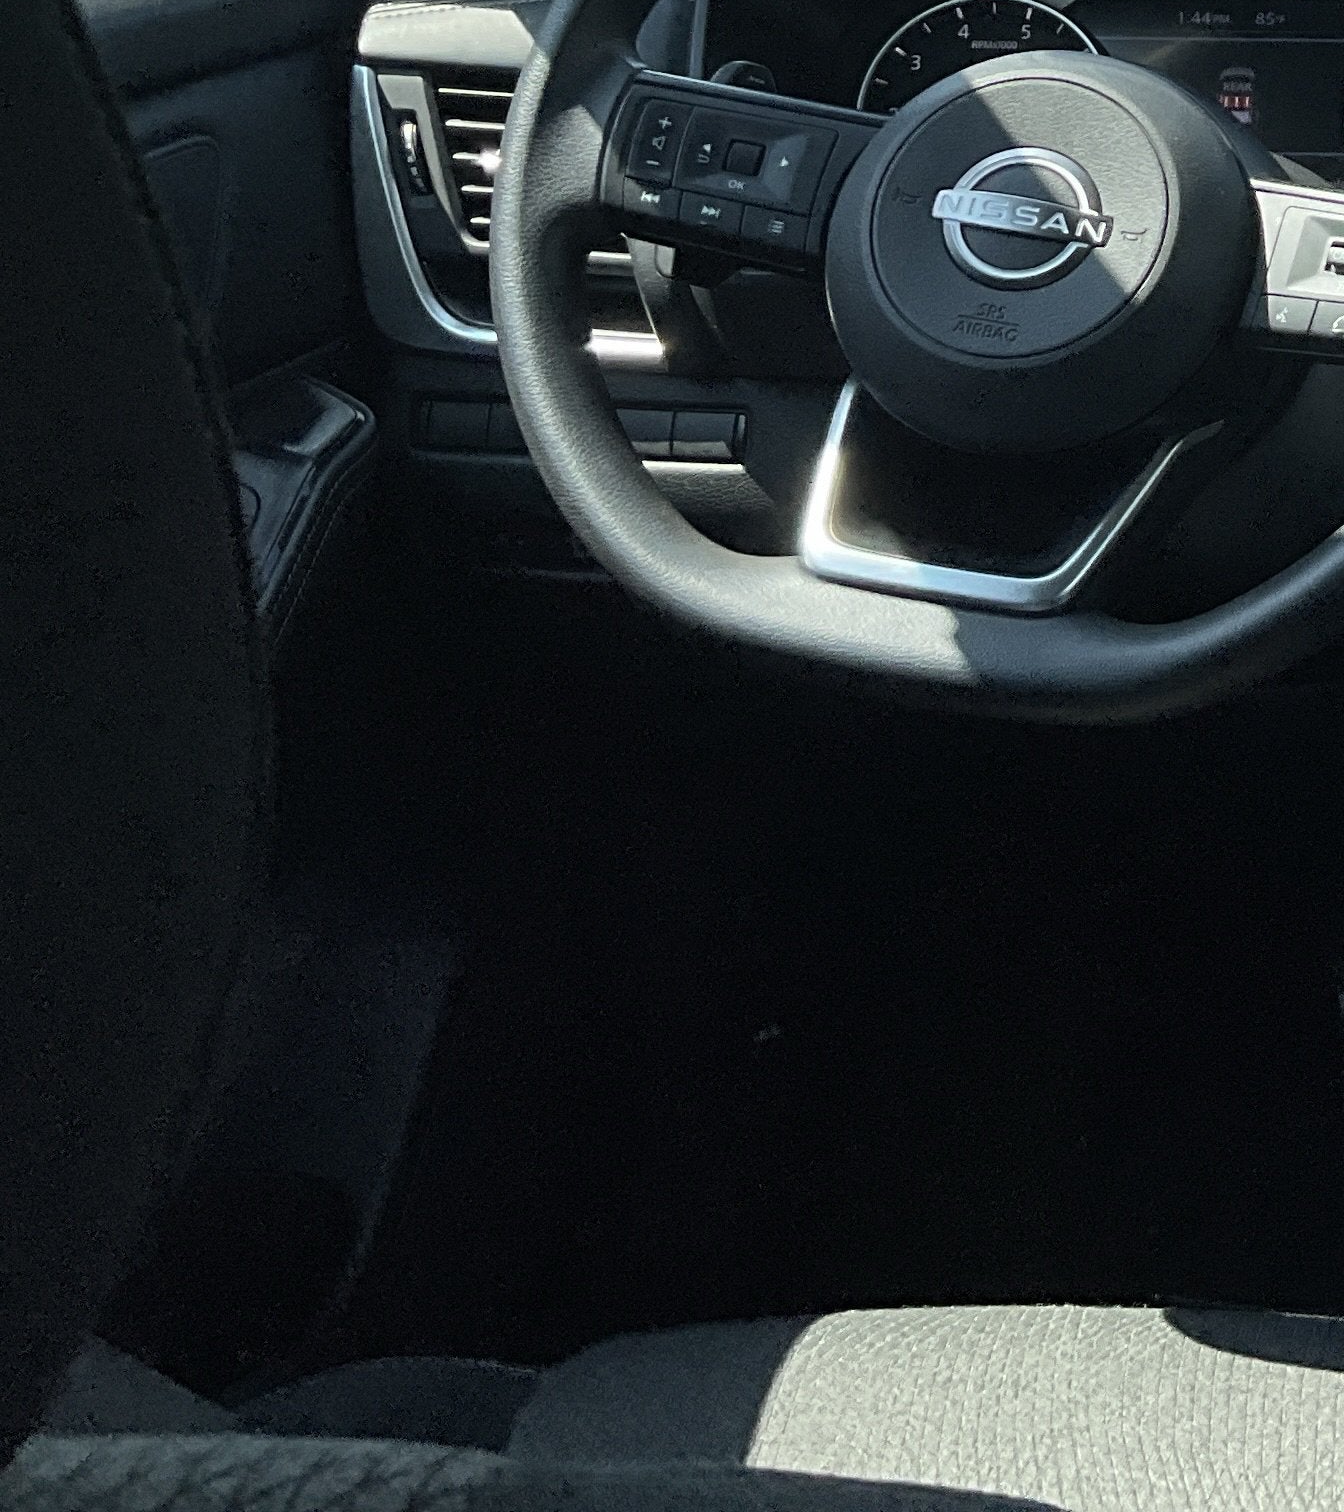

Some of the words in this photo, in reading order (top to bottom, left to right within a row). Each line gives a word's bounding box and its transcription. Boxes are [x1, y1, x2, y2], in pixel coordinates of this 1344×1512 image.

[957, 24, 970, 39] 4
[1021, 24, 1031, 39] 5
[910, 55, 921, 70] 3
[728, 179, 746, 190] OK
[938, 194, 1107, 243] NISSAN
[977, 302, 1008, 320] SRS
[953, 319, 1020, 342] AIRBAG
